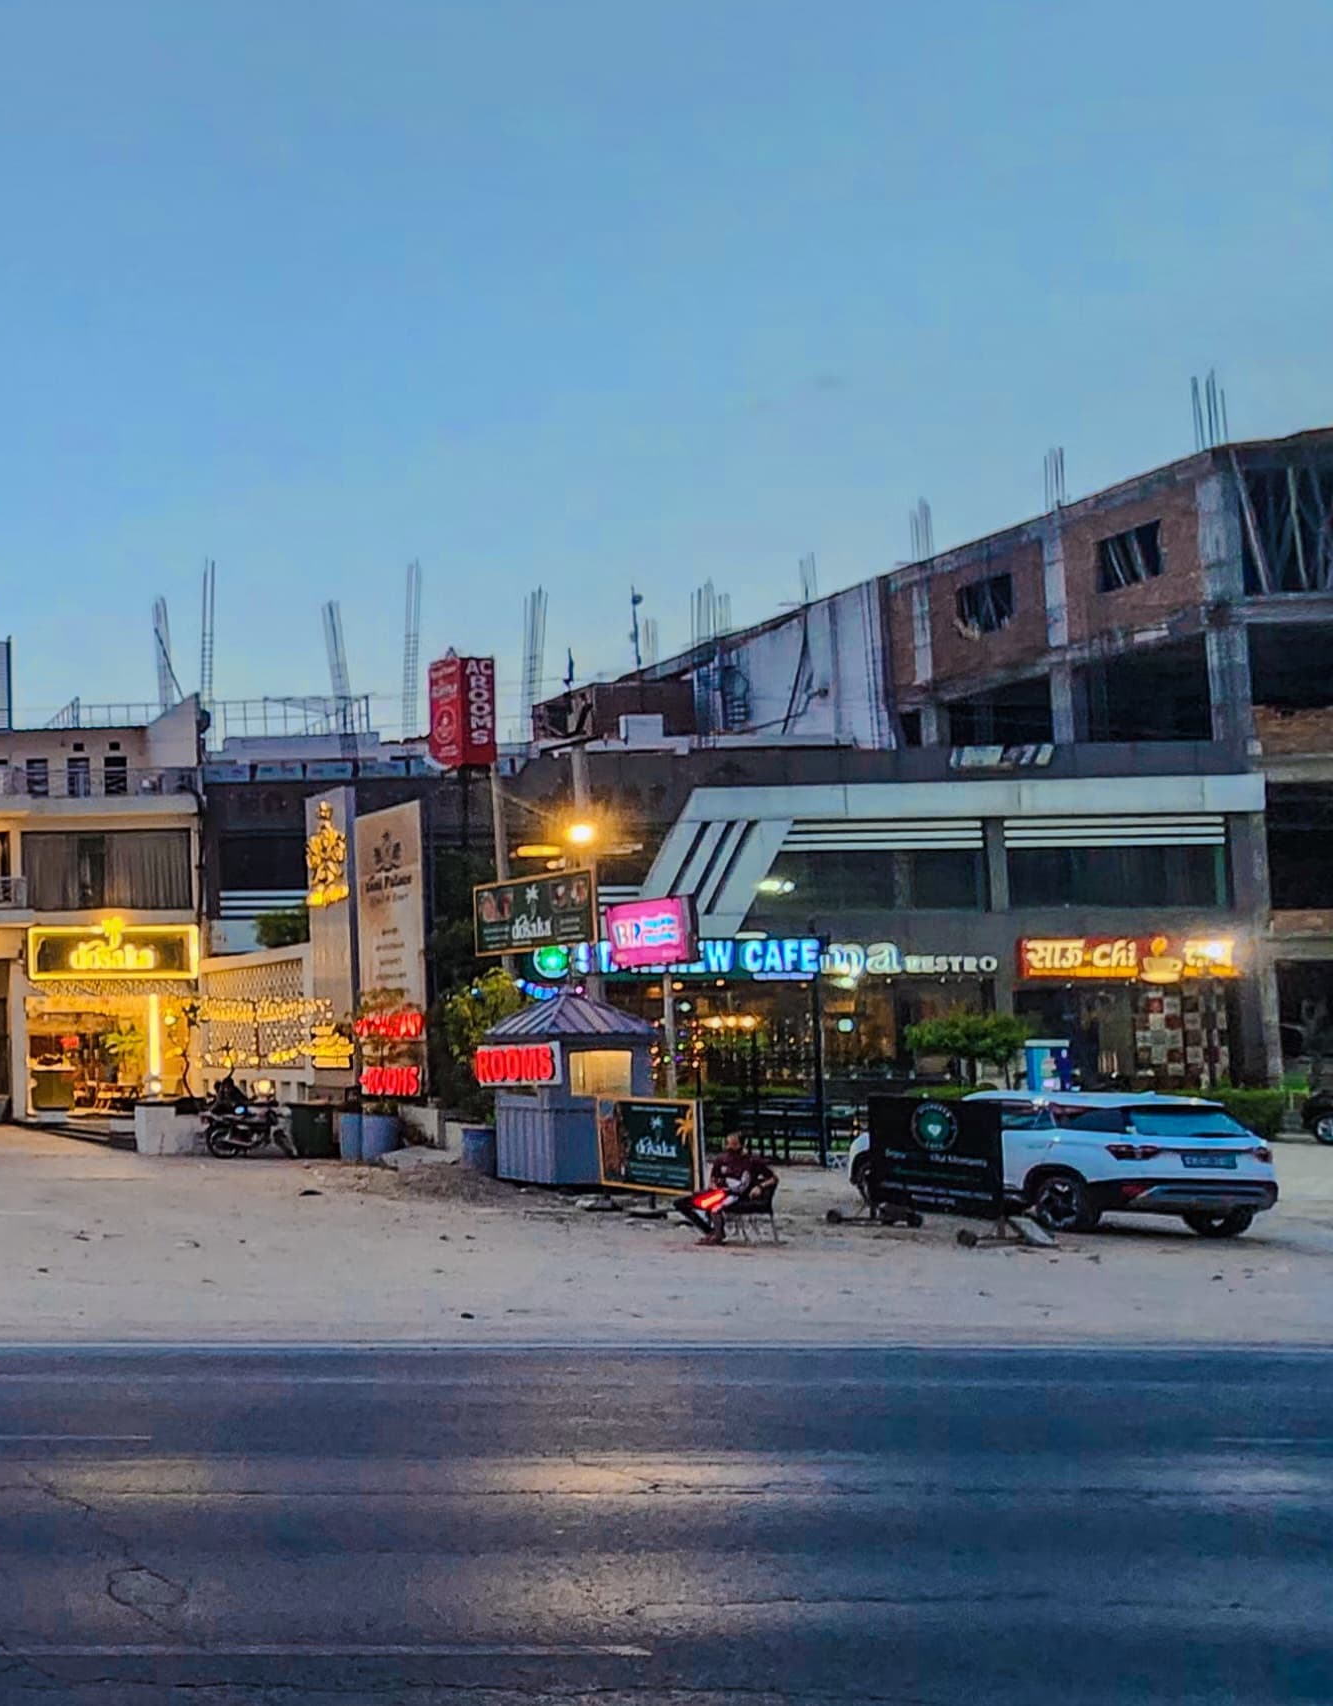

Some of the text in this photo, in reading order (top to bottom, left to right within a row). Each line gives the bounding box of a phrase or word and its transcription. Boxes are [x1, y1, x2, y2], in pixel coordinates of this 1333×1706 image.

[465, 660, 492, 675] AC
[469, 675, 492, 745] ROOMS
[742, 938, 821, 972] CAFE
[476, 1046, 553, 1083] ROOMS
